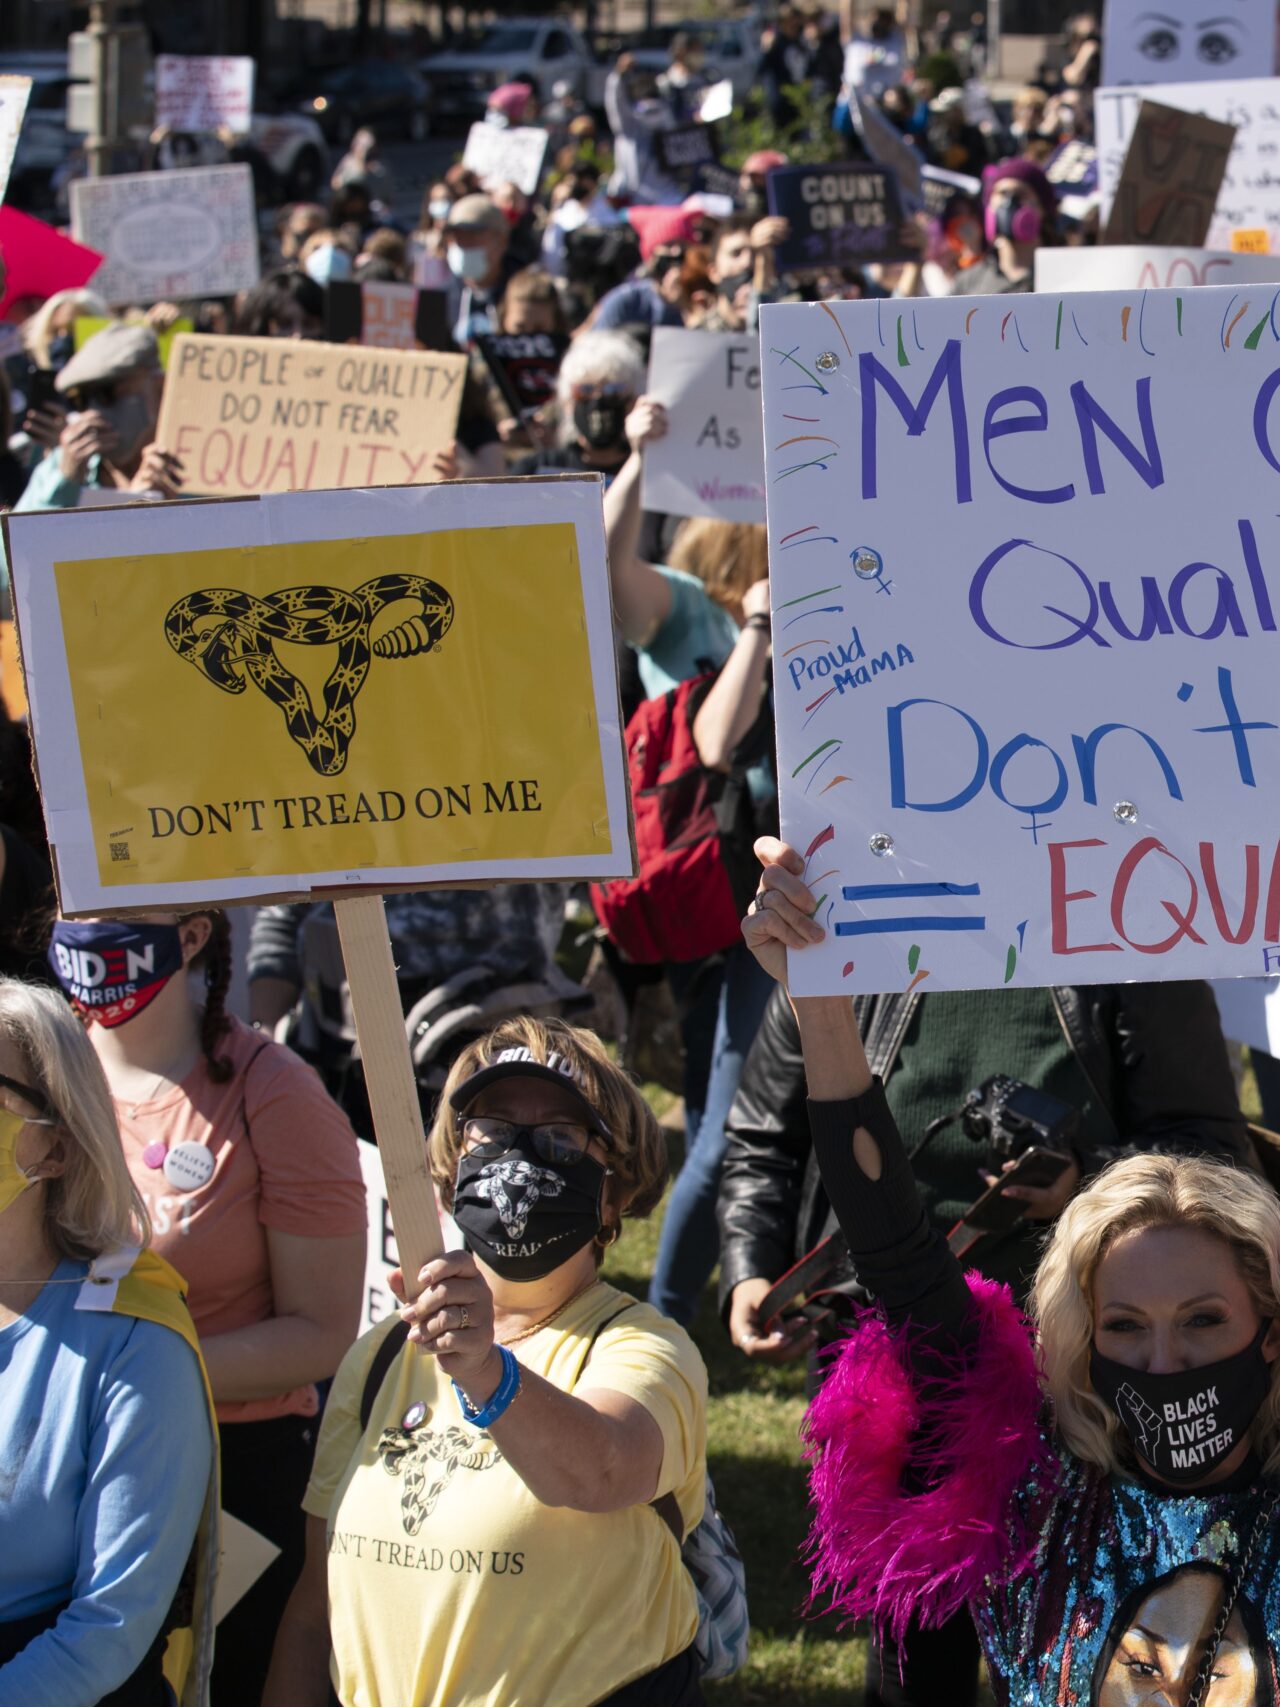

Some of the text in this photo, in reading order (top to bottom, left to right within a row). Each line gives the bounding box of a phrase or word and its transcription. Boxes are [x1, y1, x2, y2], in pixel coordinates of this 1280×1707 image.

[801, 175, 886, 203] COUNT
[810, 204, 887, 230] ON US
[178, 343, 292, 387] PEOPLE
[337, 357, 461, 400] QUALITY
[220, 393, 400, 436] DO NOT FEAR
[697, 414, 741, 449] As
[174, 425, 428, 491] EQUALITY
[788, 627, 866, 691] Proud
[887, 665, 1279, 814] Don't
[148, 779, 543, 838] DON'T TREAD ON ME
[55, 944, 155, 988] BIDEN
[70, 983, 138, 1005] HARRIS
[86, 997, 137, 1022] 020
[169, 1160, 204, 1180] WOMEN
[173, 1149, 211, 1172] BELIEVE
[1163, 1386, 1220, 1423] BLACK
[1167, 1413, 1217, 1446] LIVES
[1170, 1428, 1233, 1469] MATTER
[329, 1532, 525, 1576] ON'T TREAD ON US
